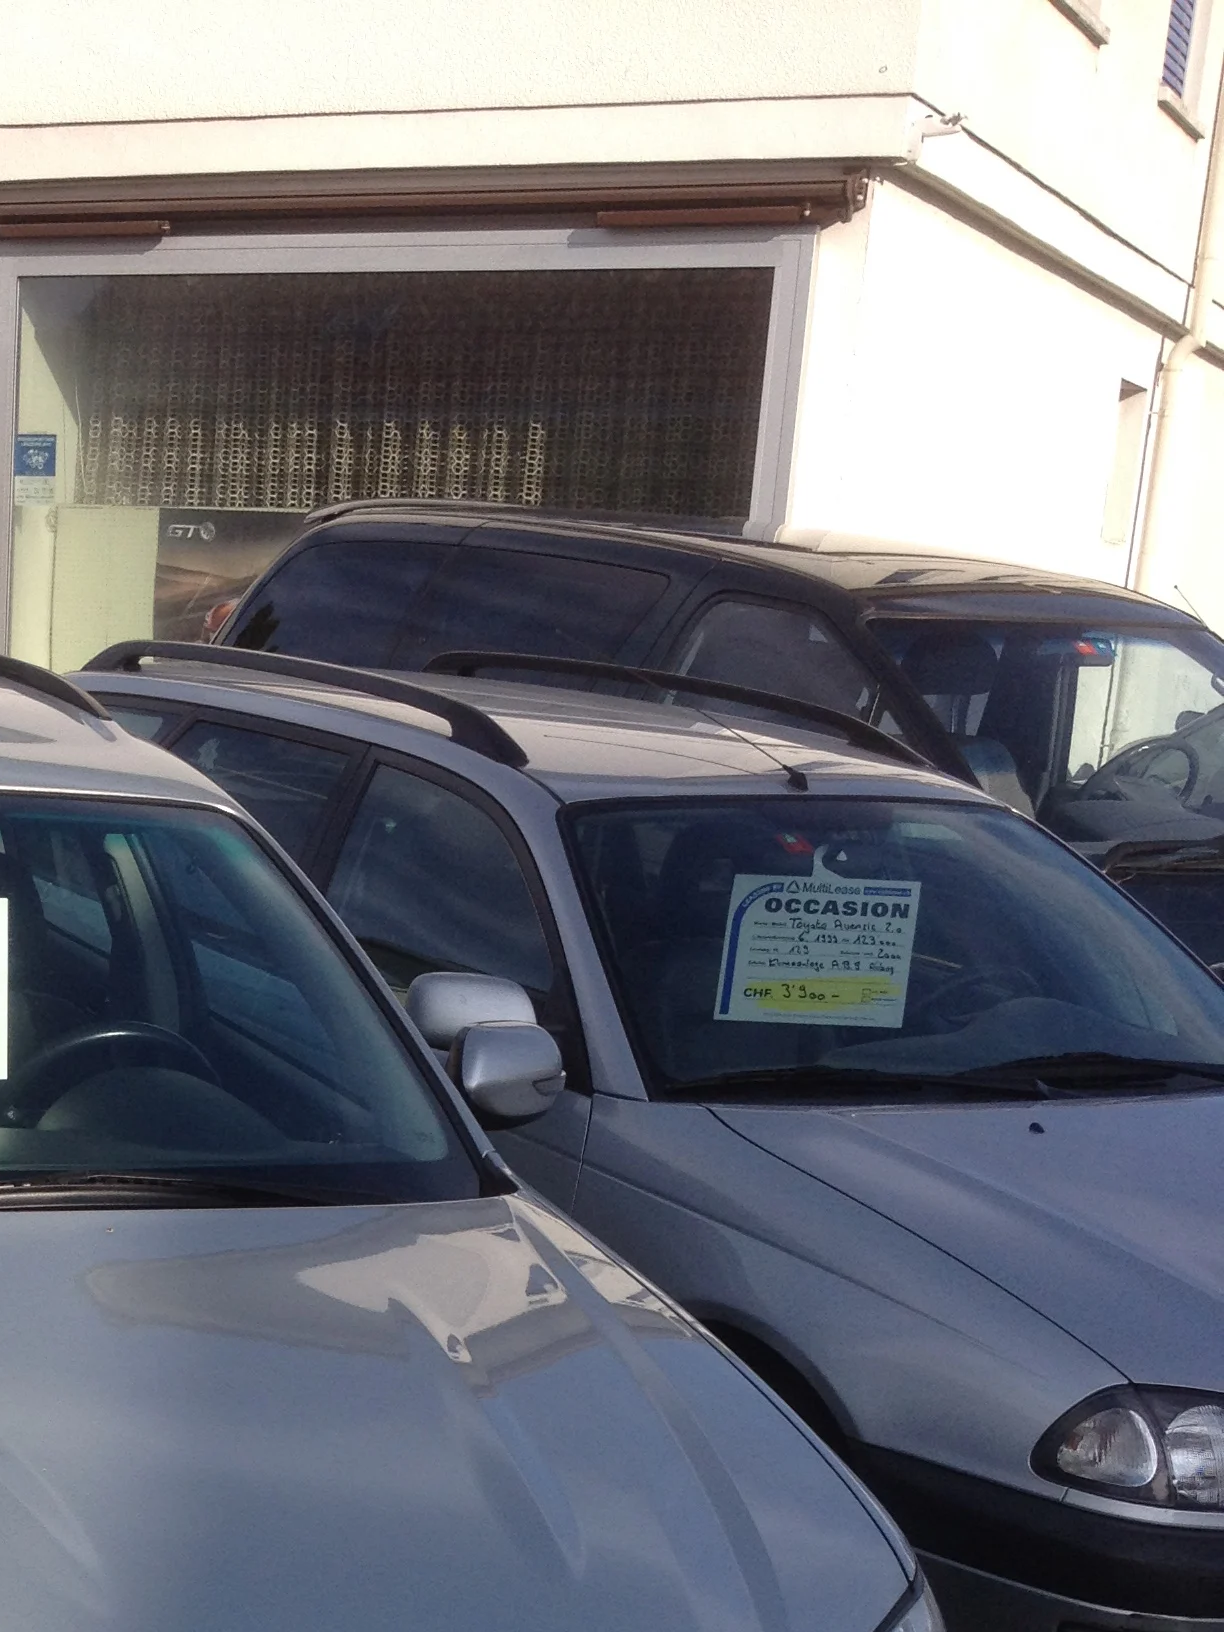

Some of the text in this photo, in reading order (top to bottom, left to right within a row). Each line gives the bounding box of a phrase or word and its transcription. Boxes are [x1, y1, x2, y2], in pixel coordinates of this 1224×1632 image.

[802, 882, 861, 895] MultiLease
[764, 897, 910, 919] OCCASION
[789, 917, 827, 934] Toyota
